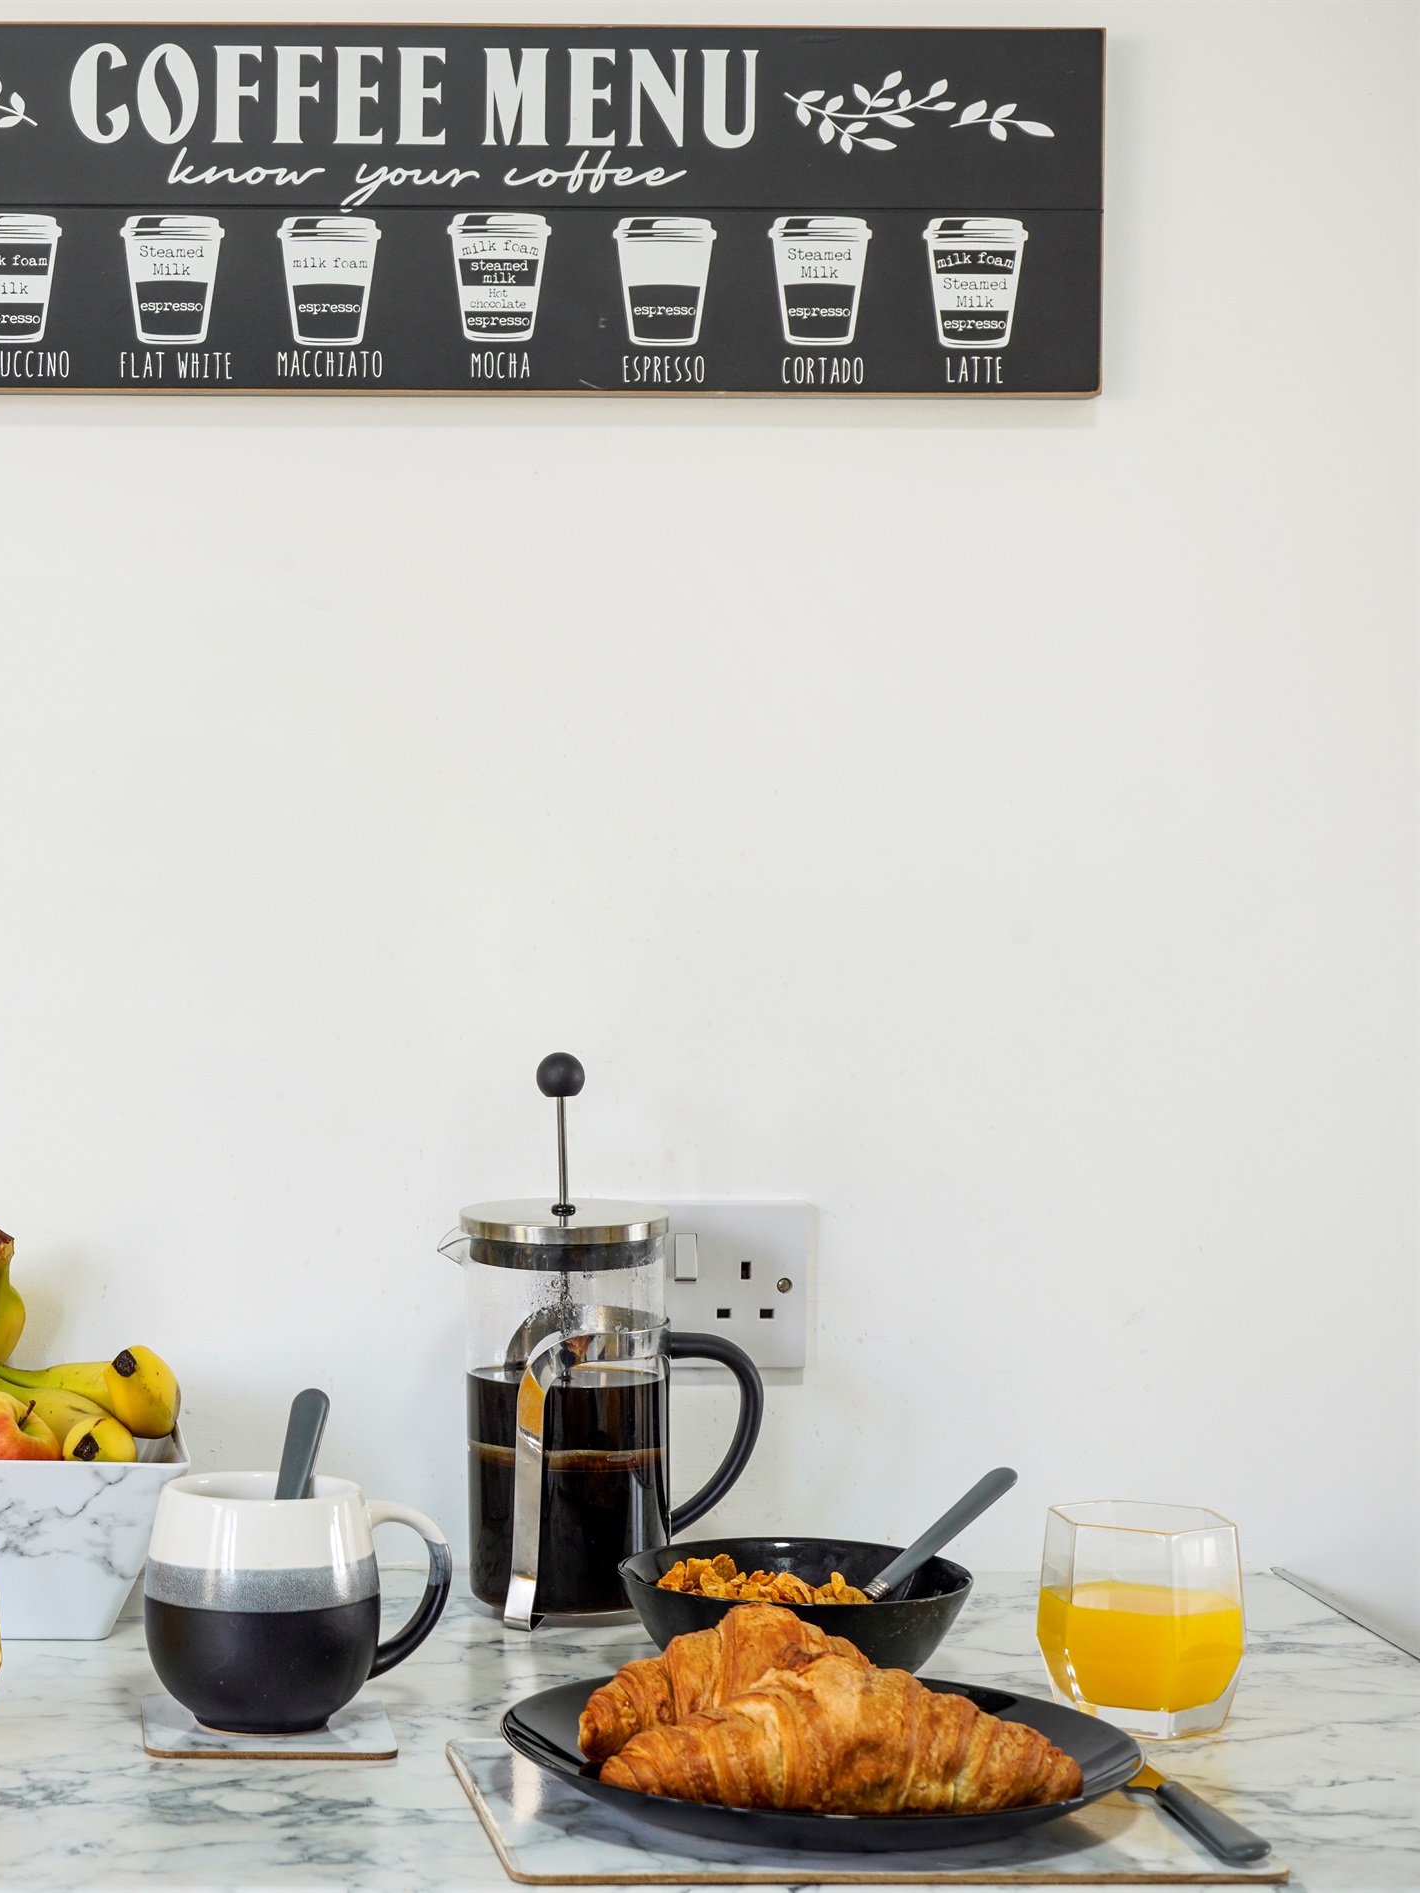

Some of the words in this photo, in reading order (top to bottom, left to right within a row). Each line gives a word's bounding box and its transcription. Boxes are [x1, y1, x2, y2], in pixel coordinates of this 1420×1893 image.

[70, 43, 446, 145] COFFEE
[482, 48, 759, 148] MENU
[168, 147, 325, 185] know
[341, 162, 481, 212] your
[504, 150, 687, 193] coffee
[140, 245, 204, 258] Steamed
[462, 241, 496, 254] milk
[504, 240, 536, 255] foam
[13, 255, 47, 266] foam
[788, 248, 852, 261] Steamed
[936, 252, 972, 267] milk
[977, 251, 1014, 268] foam
[153, 263, 190, 275] Milk
[292, 257, 328, 269] milk
[333, 256, 368, 269] foam
[471, 260, 528, 271] steamed
[483, 272, 516, 283] milk
[801, 266, 838, 278] Milk
[944, 278, 1007, 290] Steamed
[488, 288, 508, 298] Hot
[140, 302, 203, 313] espresso
[469, 299, 527, 309] chocolate
[957, 296, 993, 307] Milk
[298, 304, 361, 314] espresso
[634, 306, 696, 317] espresso
[787, 307, 852, 320] espresso
[467, 316, 530, 328] espresso
[943, 319, 1007, 333] espresso
[121, 352, 165, 378] FLAT
[178, 352, 232, 379] WHITE
[278, 351, 382, 377] MACCHIATO
[472, 352, 529, 378] MOCHA
[623, 356, 704, 383] ESPRESSO
[783, 357, 863, 384] CORTADO
[947, 356, 1003, 383] LATTE
